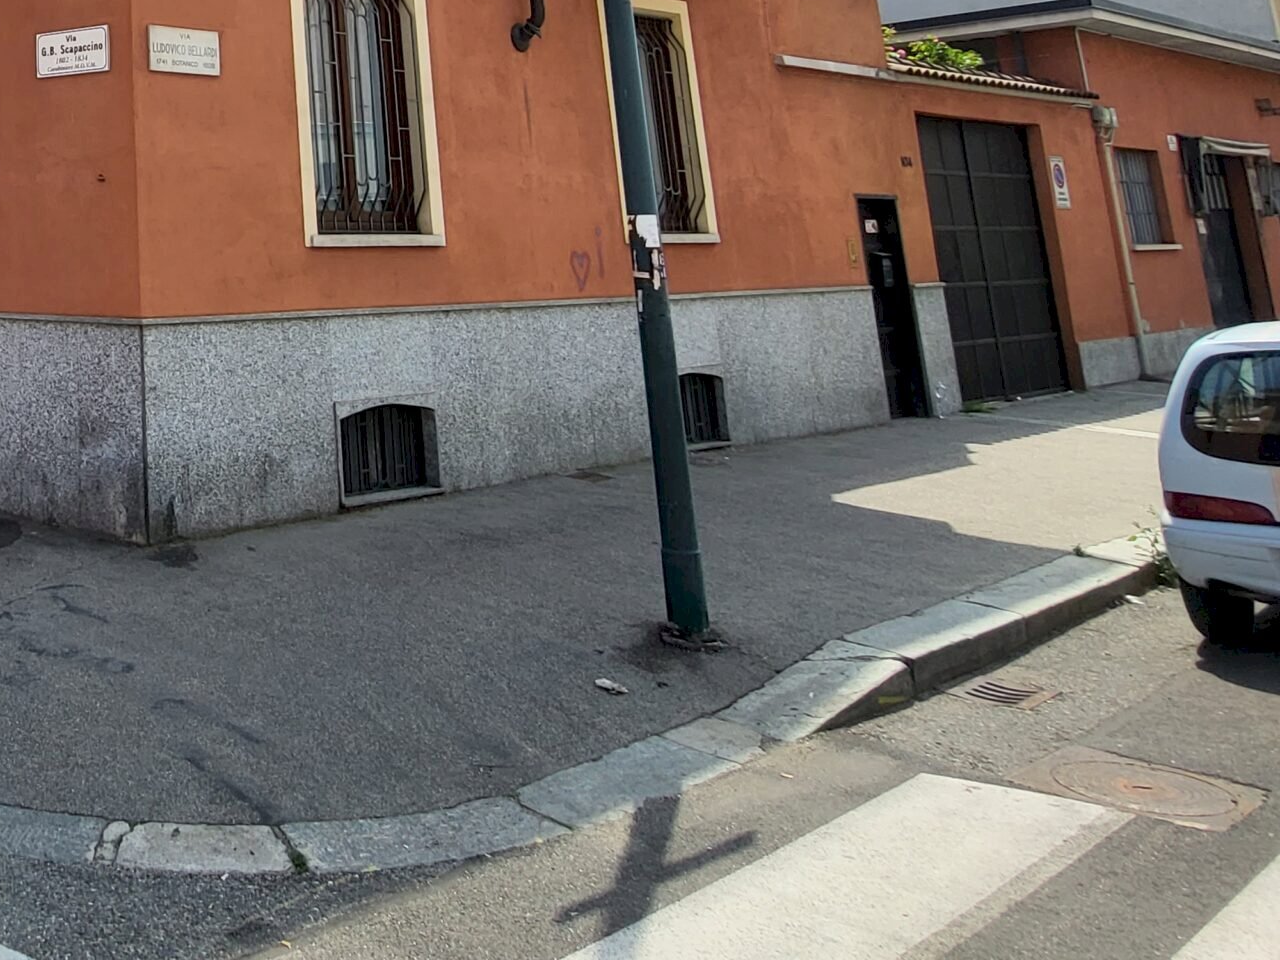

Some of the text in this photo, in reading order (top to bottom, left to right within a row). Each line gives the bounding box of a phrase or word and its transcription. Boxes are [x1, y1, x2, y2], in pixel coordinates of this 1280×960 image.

[65, 34, 77, 42] Via
[60, 41, 103, 55] Scapaccino
[152, 42, 186, 55] LUDOVICO
